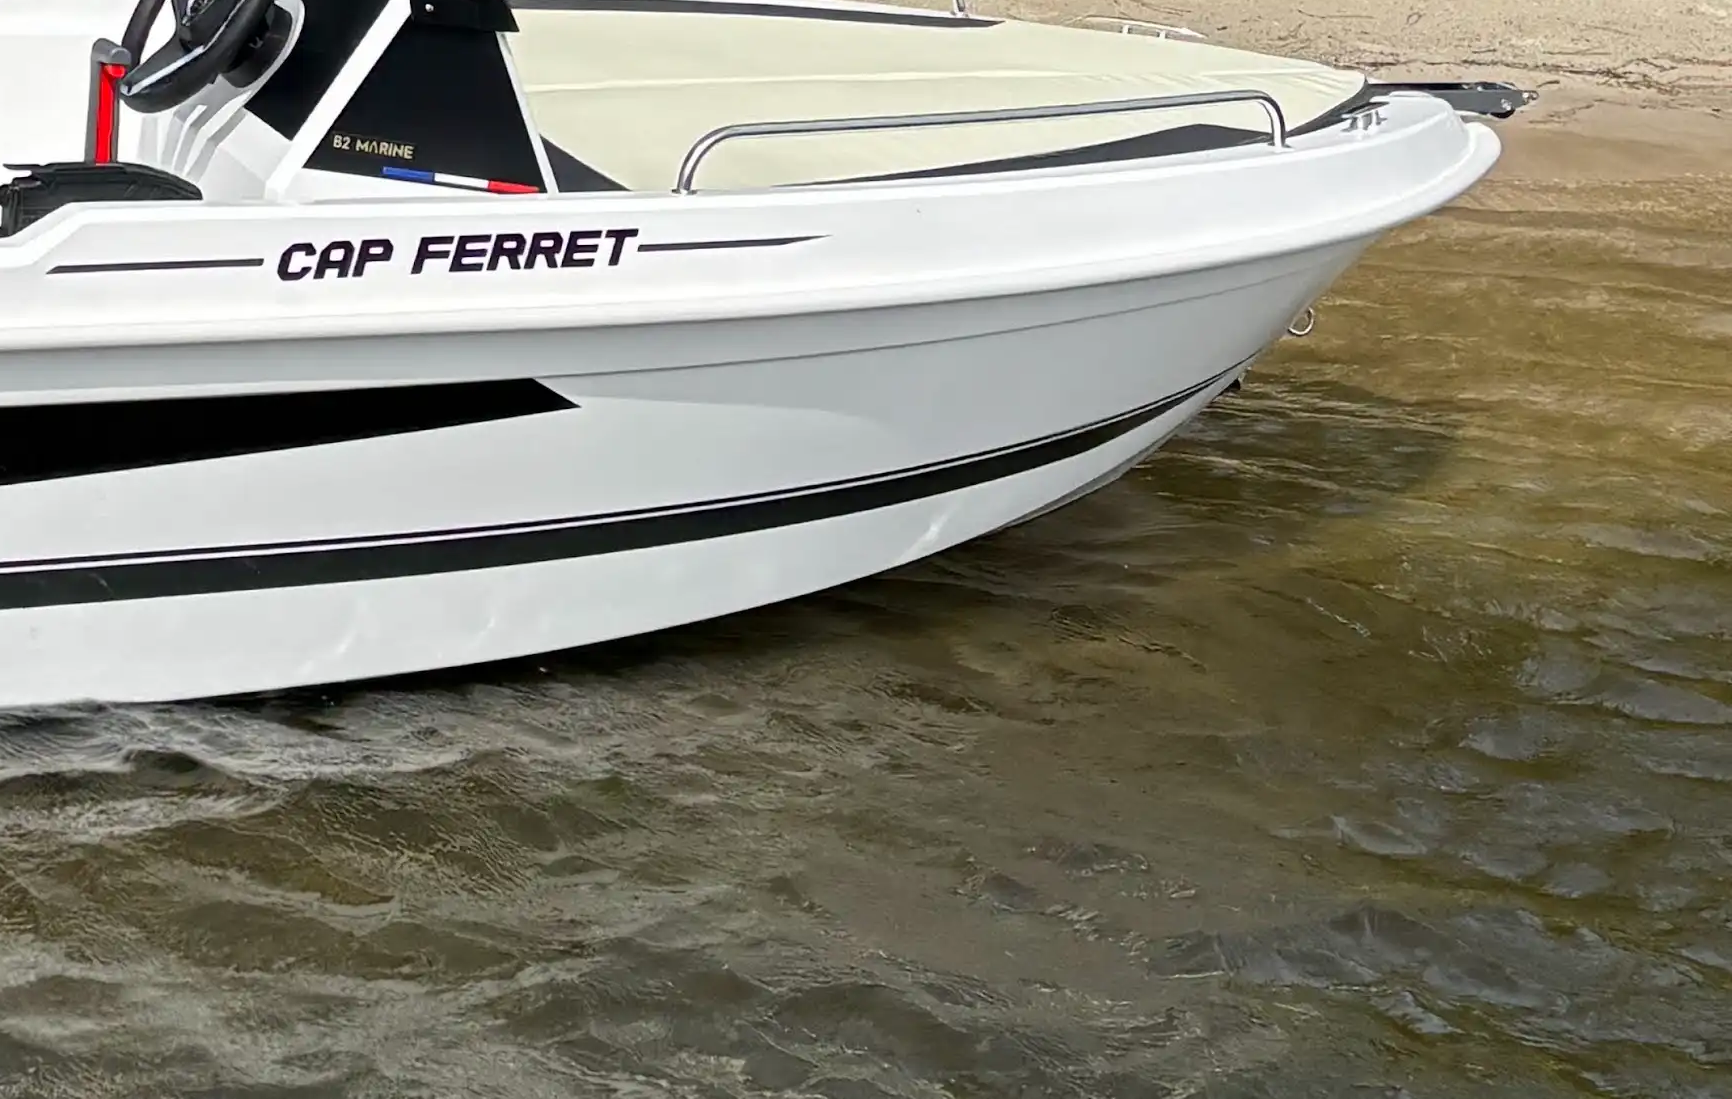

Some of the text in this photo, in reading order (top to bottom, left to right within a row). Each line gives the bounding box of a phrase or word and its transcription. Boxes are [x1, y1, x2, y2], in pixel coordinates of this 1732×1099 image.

[332, 134, 415, 160] B2 MARINE
[277, 228, 639, 281] CAP FERRET
